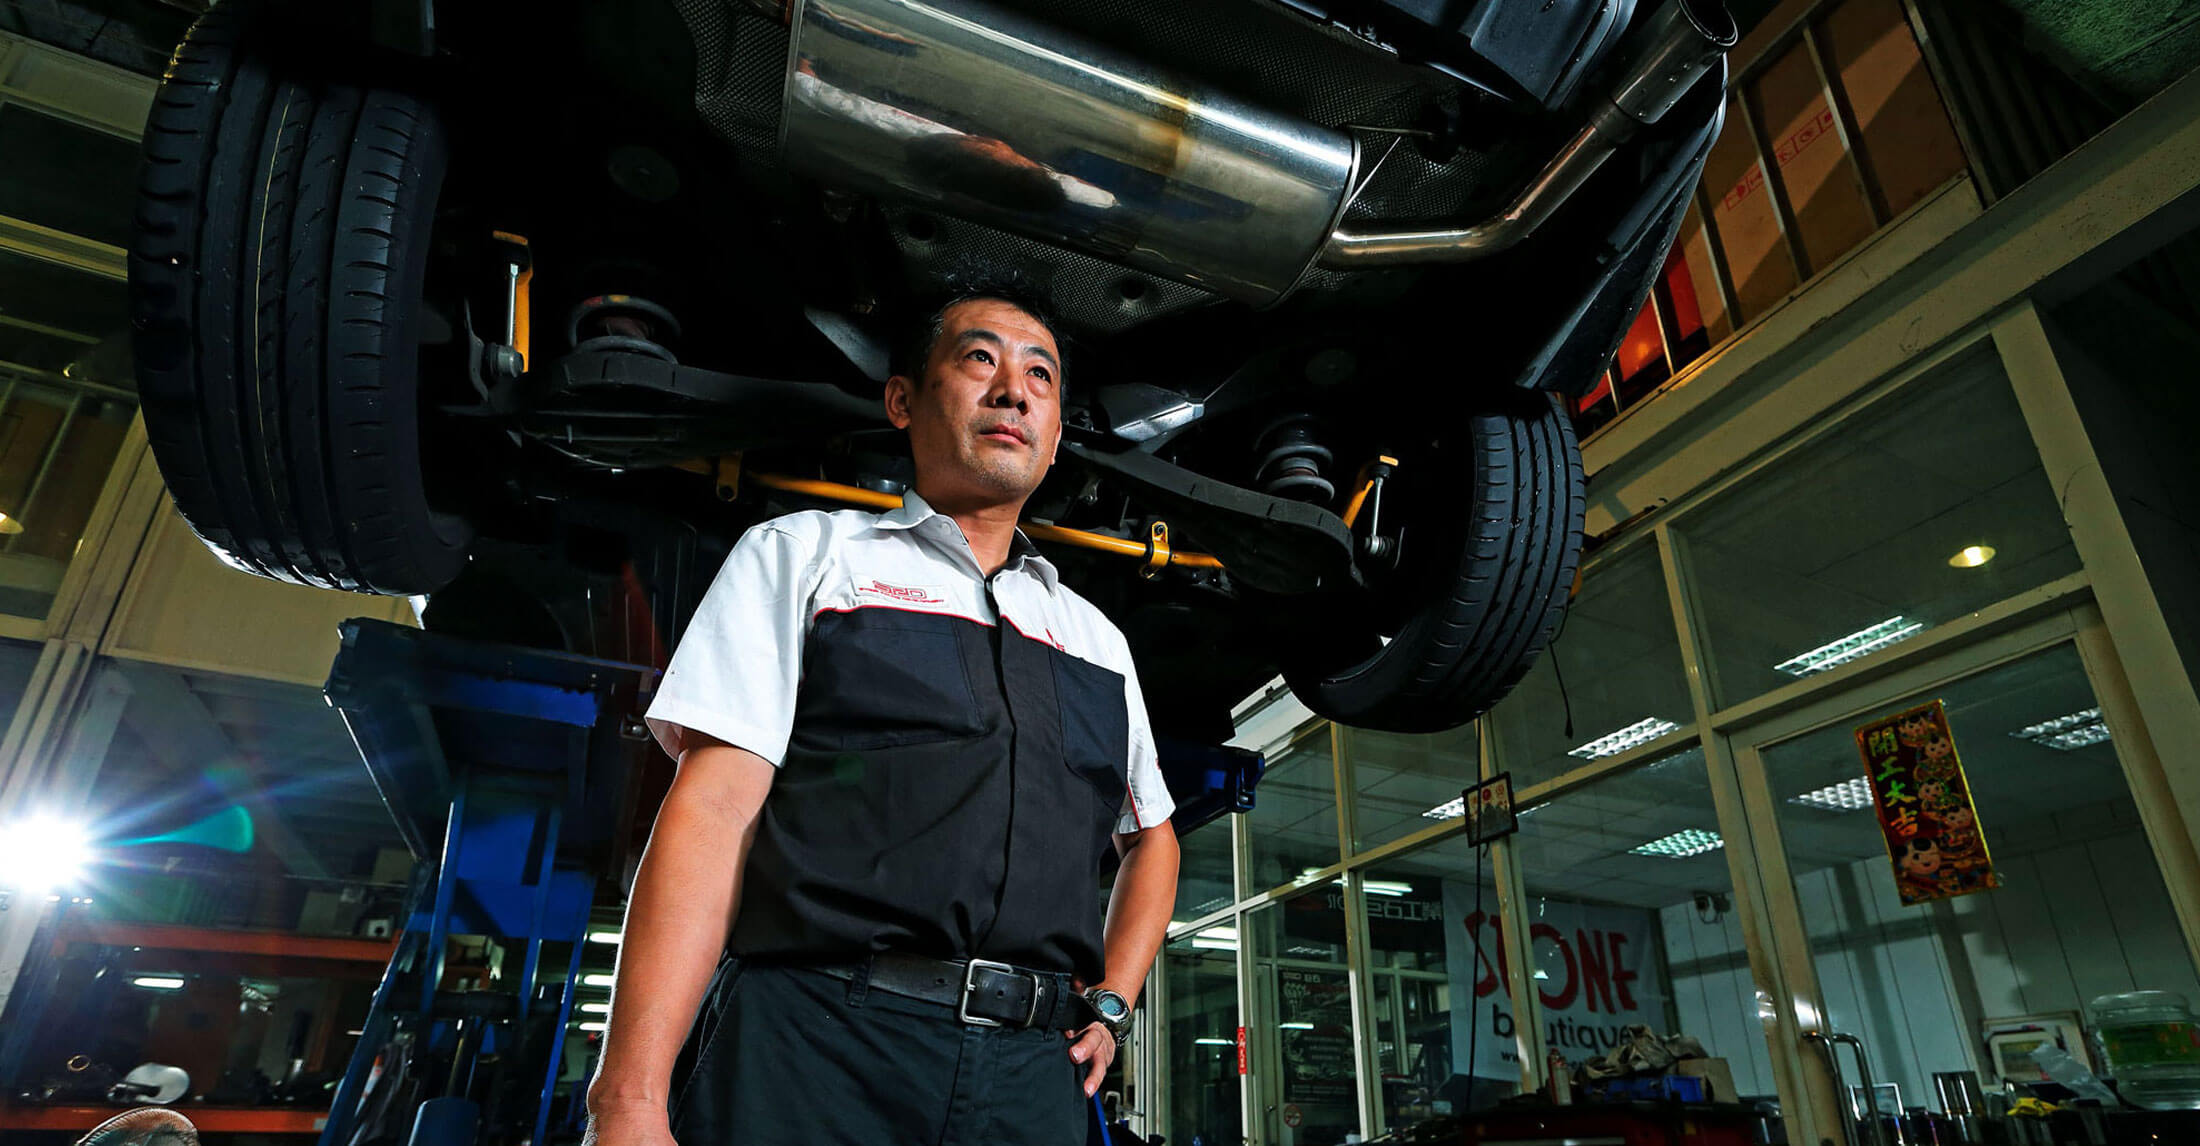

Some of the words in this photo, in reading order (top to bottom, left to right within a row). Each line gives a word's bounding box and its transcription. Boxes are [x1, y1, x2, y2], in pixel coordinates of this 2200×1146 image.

[1868, 726, 1917, 837] 開工大吉
[1464, 910, 1638, 1014] STONE
[1493, 1003, 1631, 1055] butique
